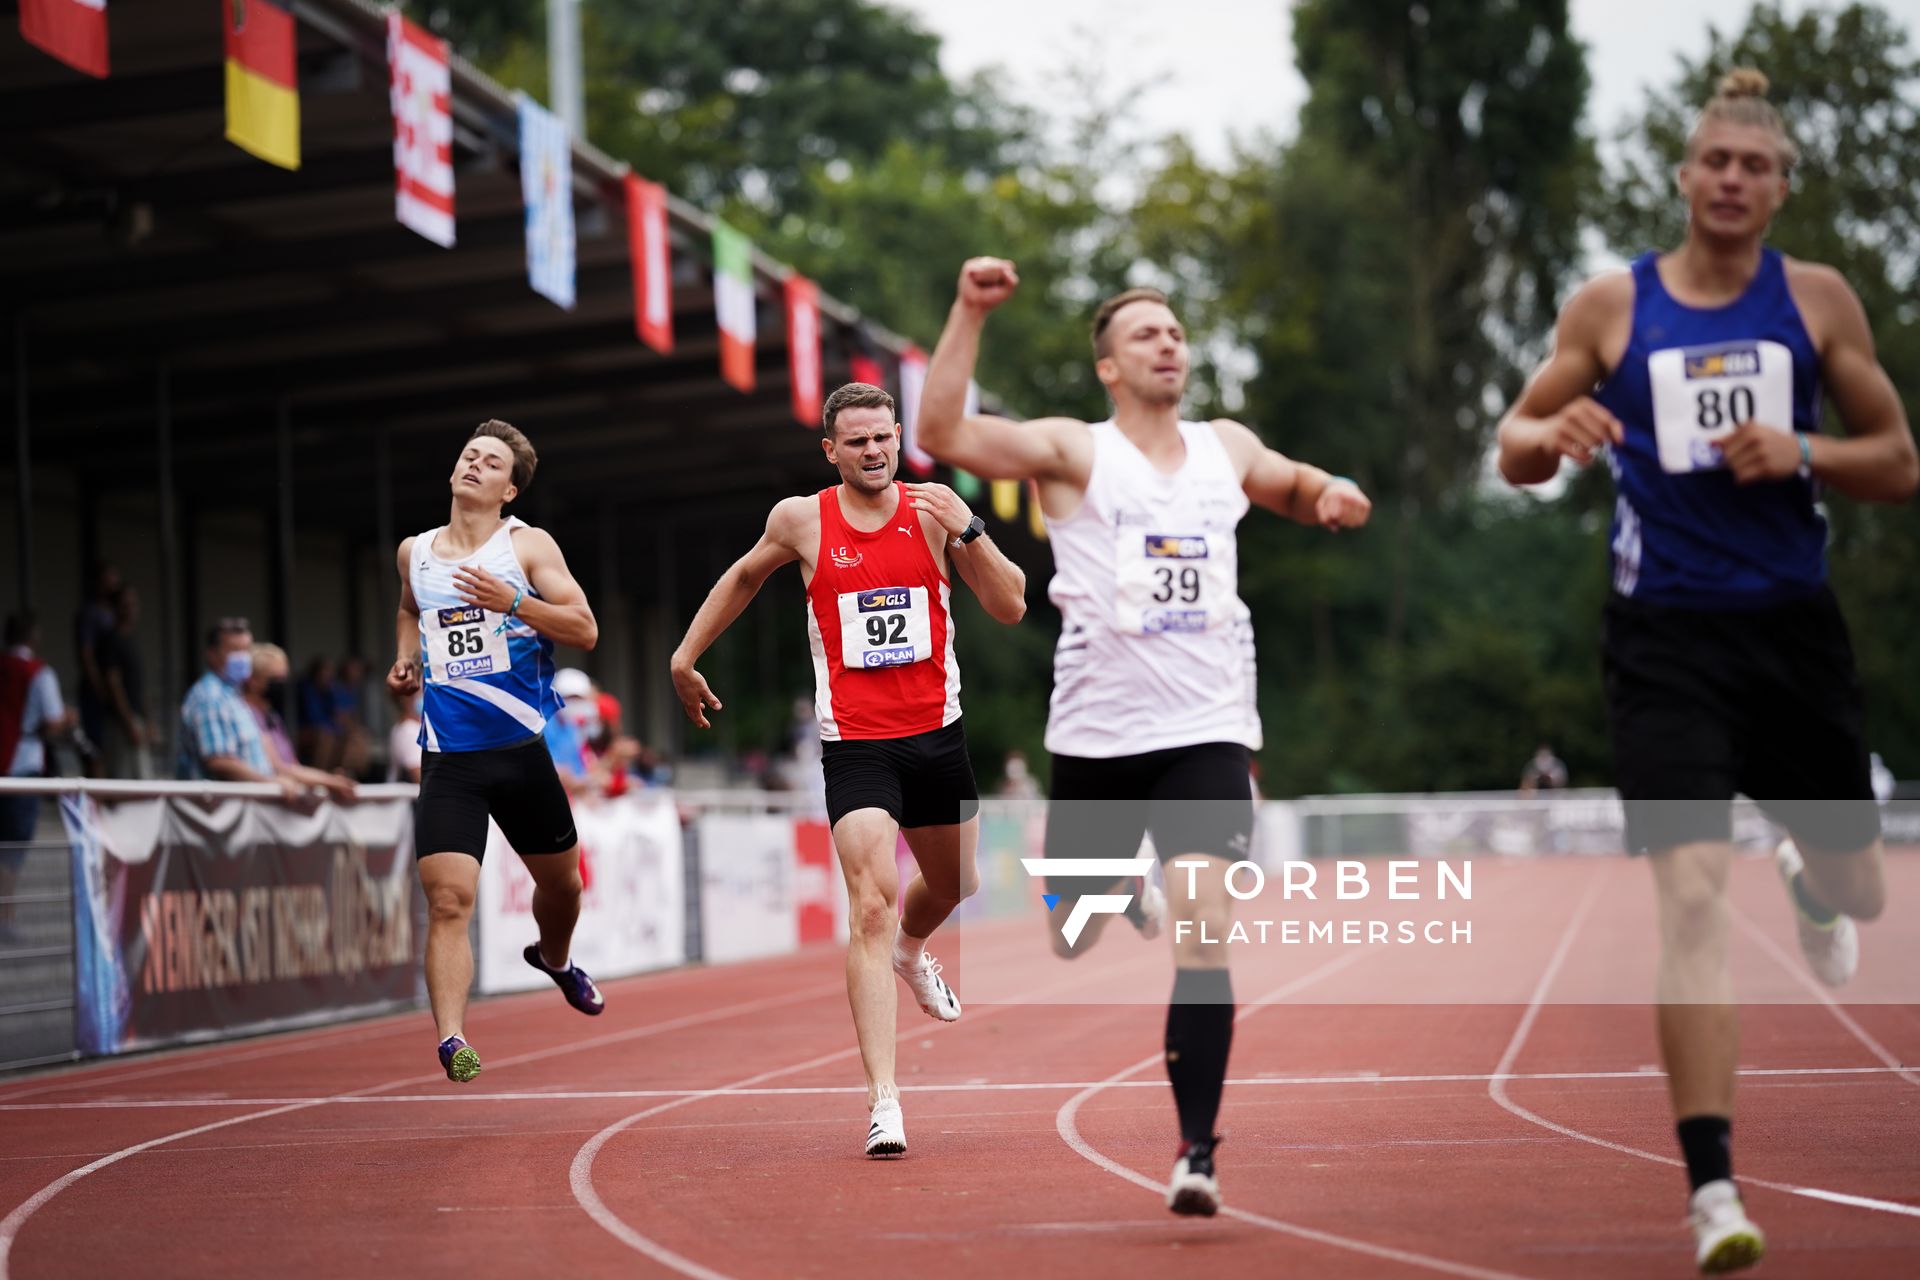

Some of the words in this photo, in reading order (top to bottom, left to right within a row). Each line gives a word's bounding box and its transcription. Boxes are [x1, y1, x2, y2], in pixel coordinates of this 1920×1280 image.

[1697, 386, 1755, 430] 80
[1153, 567, 1200, 603] 39
[885, 593, 907, 606] GLS
[463, 608, 481, 621] GLS
[866, 613, 908, 646] 92
[448, 627, 483, 657] 85
[463, 658, 491, 670] PLAN
[884, 650, 913, 661] PLAN
